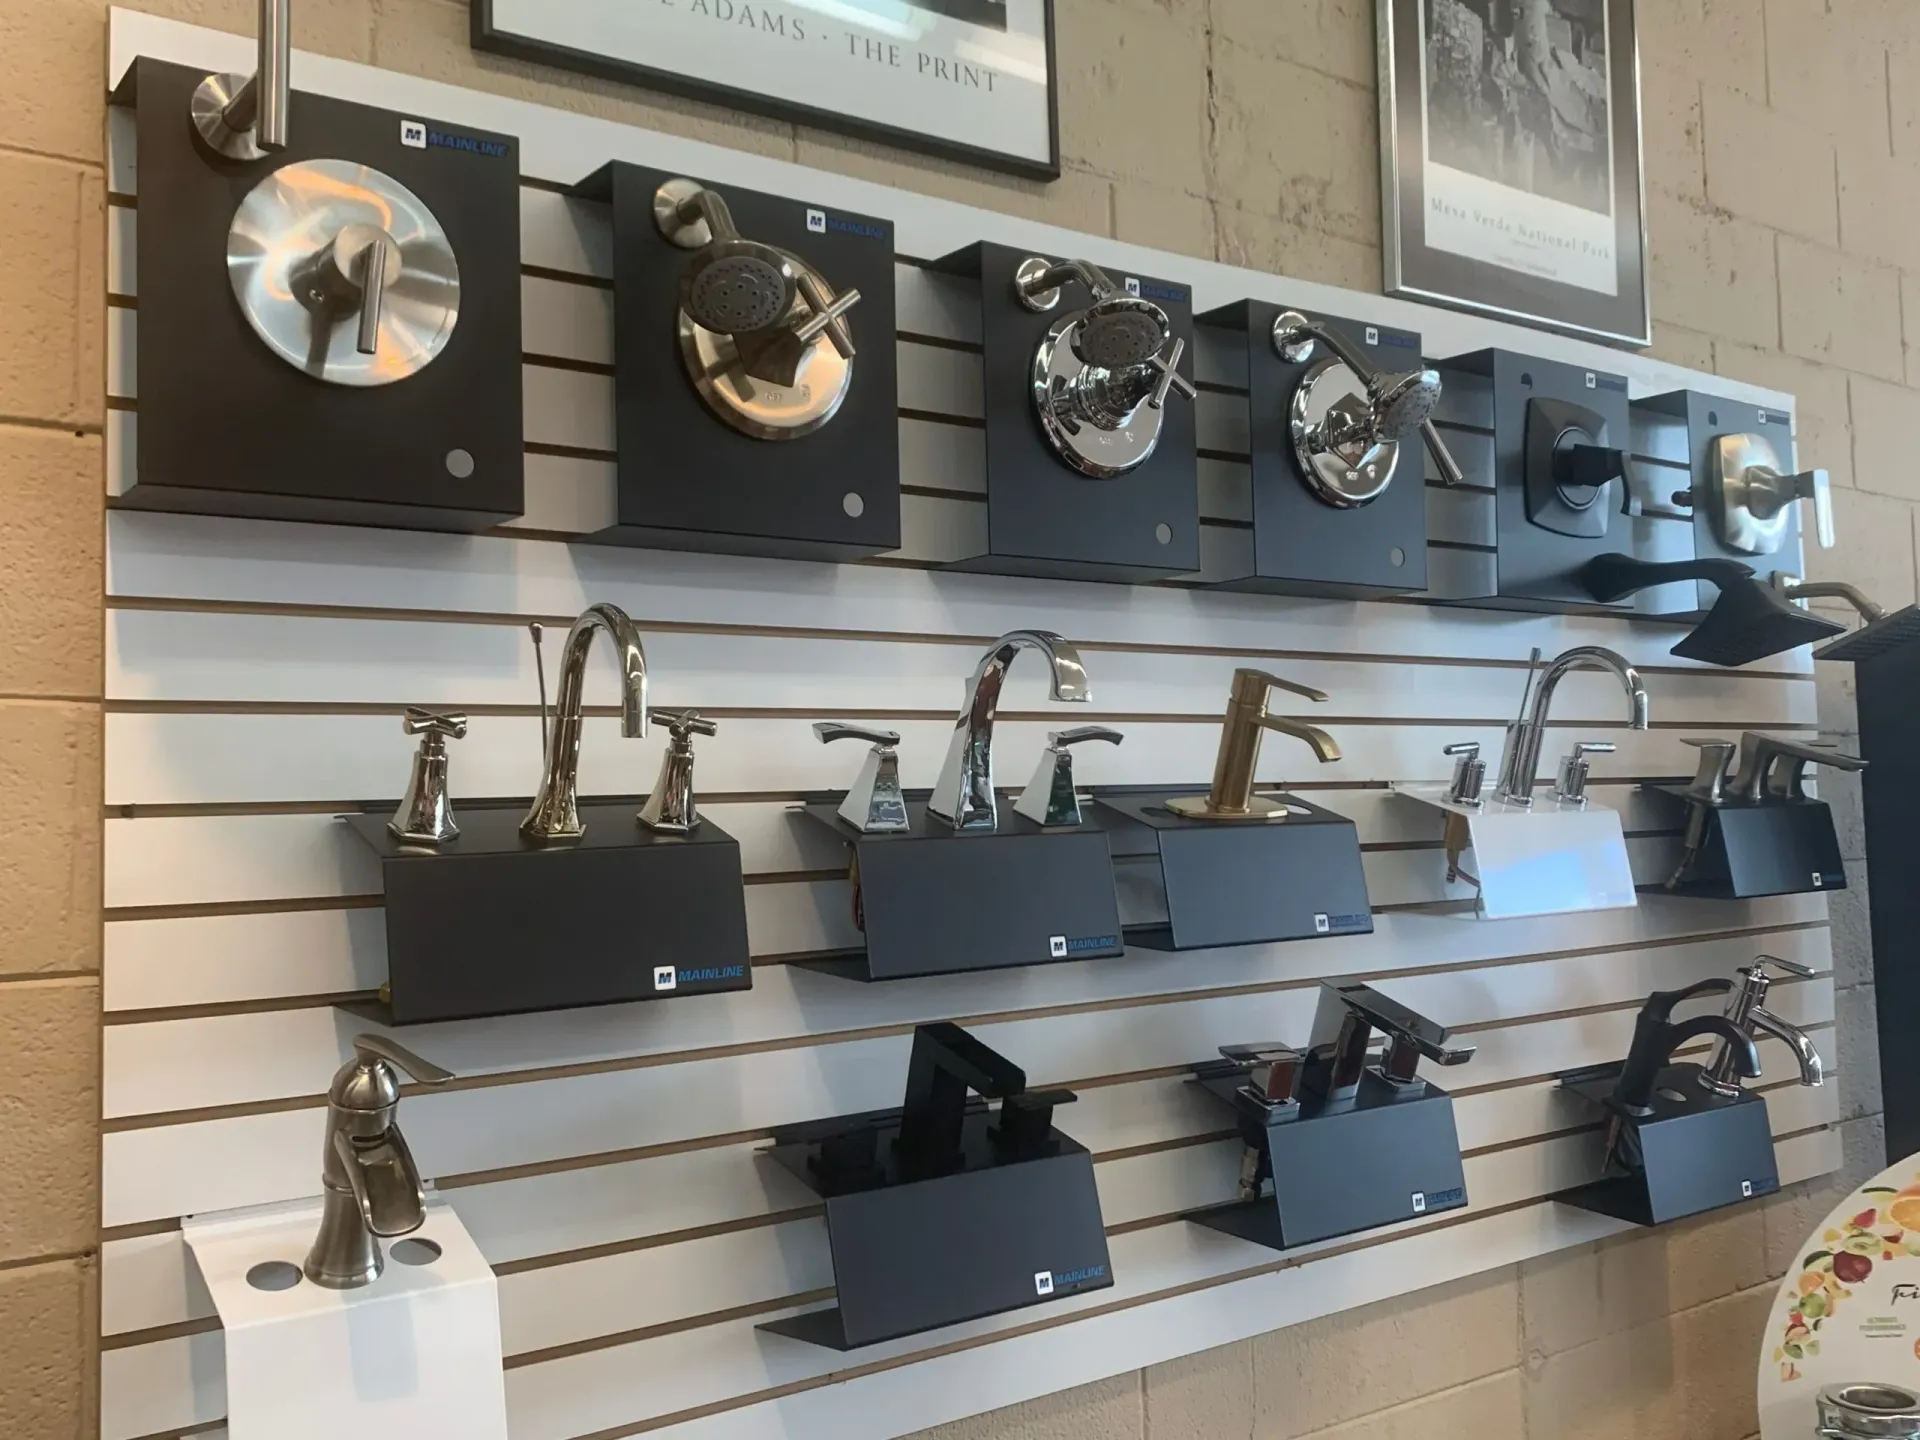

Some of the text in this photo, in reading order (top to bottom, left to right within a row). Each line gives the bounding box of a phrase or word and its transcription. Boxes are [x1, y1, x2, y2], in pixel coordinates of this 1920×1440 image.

[690, 0, 998, 92] ADAMS THE PRINT
[428, 132, 508, 157] MAINLINE
[1431, 197, 1466, 220] Mesa
[1474, 210, 1511, 233] Verde
[1518, 223, 1576, 250] National
[1583, 240, 1609, 259] Park
[677, 965, 745, 982] MAINLINE
[1053, 1264, 1107, 1286] MAINLINE
